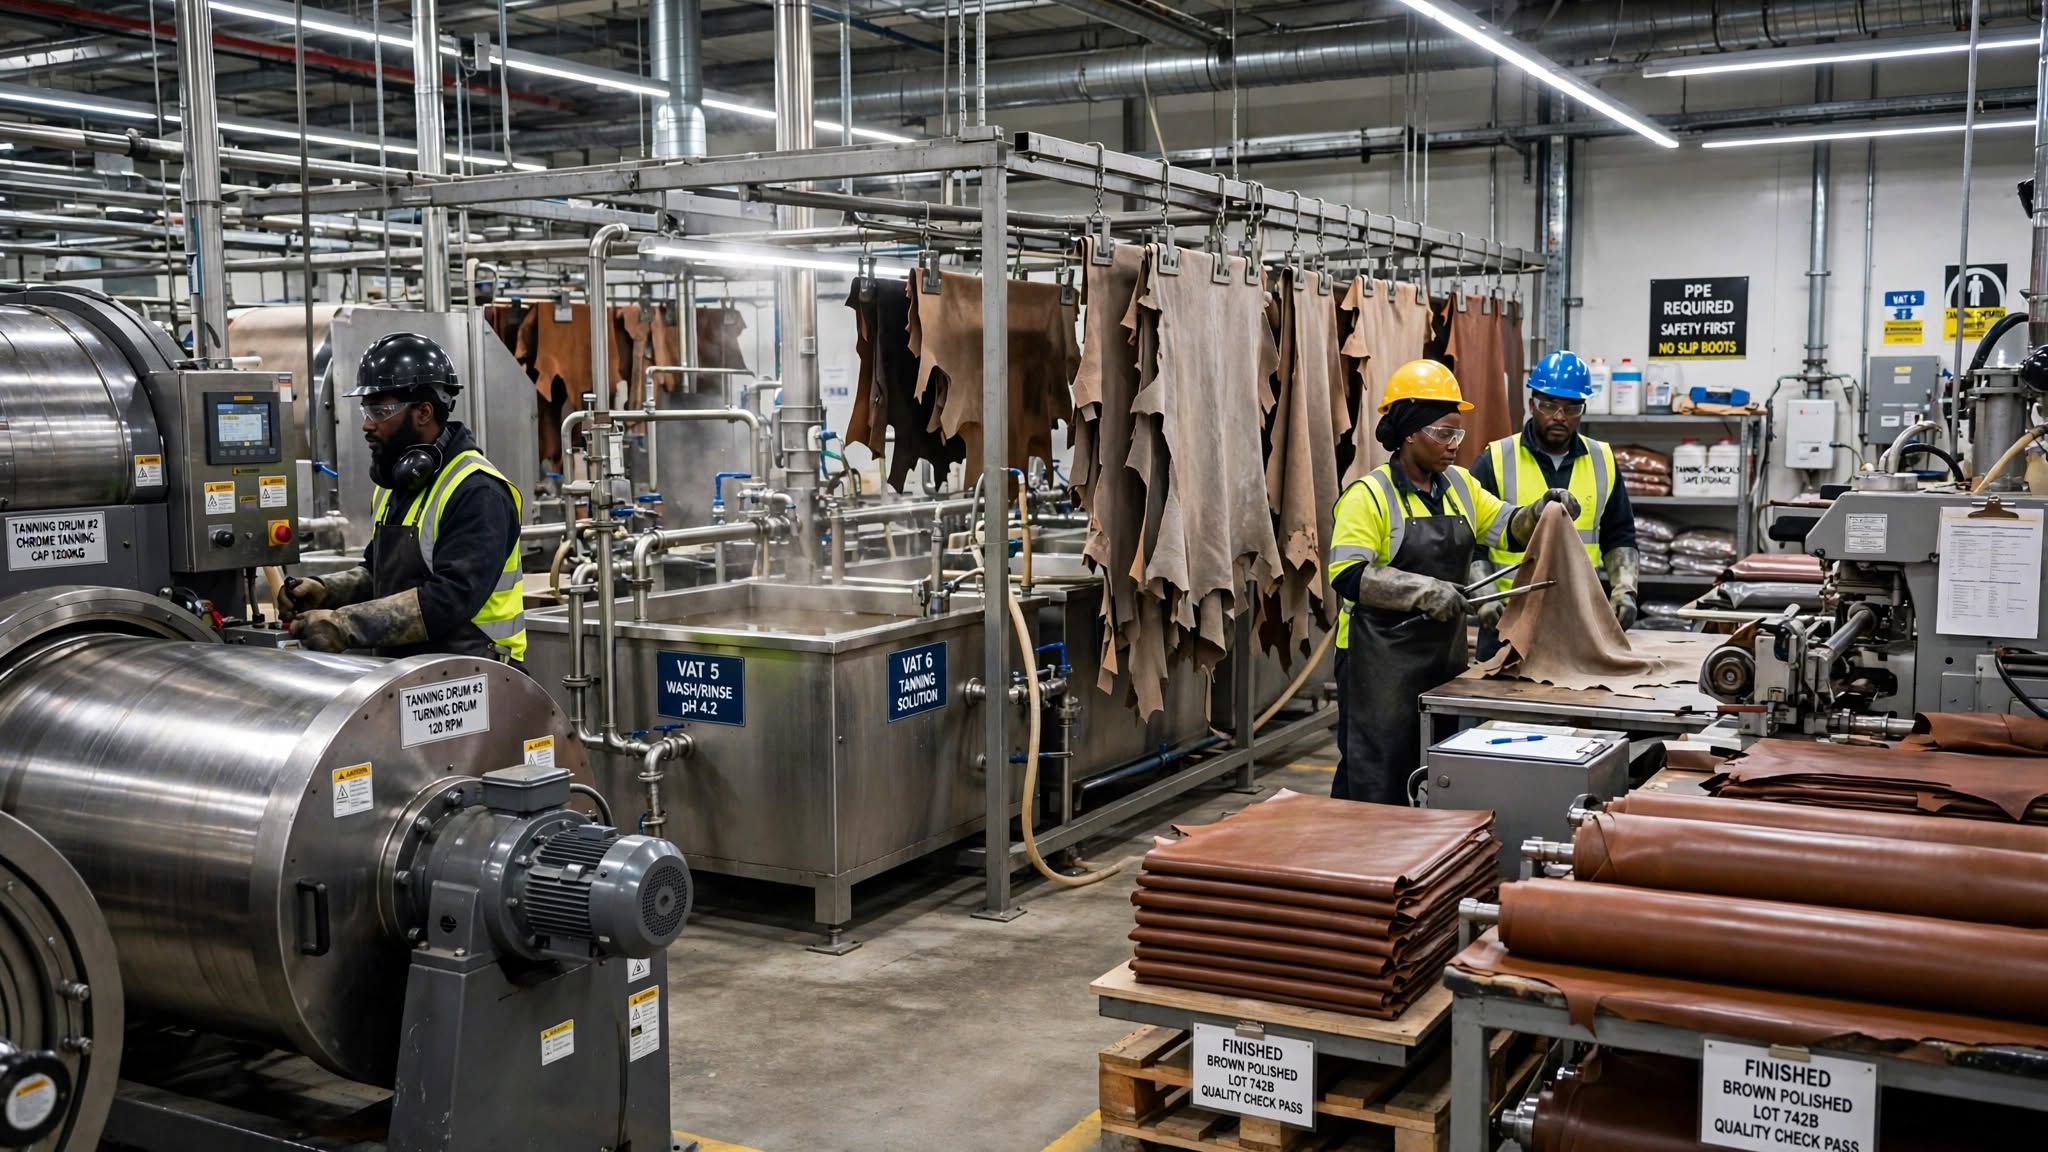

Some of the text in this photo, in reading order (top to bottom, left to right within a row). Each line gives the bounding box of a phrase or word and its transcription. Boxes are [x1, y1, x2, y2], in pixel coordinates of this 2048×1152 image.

[1685, 284, 1712, 298] PPE
[1664, 300, 1734, 316] REQUIRED
[1661, 321, 1735, 336] SAFETY FIRST
[1659, 341, 1736, 354] NO SLIP BOOTS
[12, 519, 98, 534] TANNING DRUM #2
[16, 533, 95, 548] CHROME TANNING
[31, 550, 49, 561] CAP
[677, 660, 719, 680] VAT 5
[902, 652, 933, 674] VAT 6
[666, 680, 733, 699] WASH/RINSE
[899, 672, 935, 693] TANNING
[406, 682, 482, 707] TANNING DRUM #3
[897, 689, 938, 711] SOLUTION
[412, 699, 476, 721] TURNING DRUM
[682, 700, 717, 715] pH 4.2
[428, 718, 463, 734] 120 RPM
[1222, 1039, 1283, 1061] FINISHED
[1207, 1055, 1298, 1081] BROWN POLISHED
[1745, 1059, 1831, 1088] FINISHED
[1228, 1074, 1275, 1092] LOT 742B
[1201, 1085, 1303, 1114] QUALITY CHECK PASS
[1723, 1080, 1852, 1113] BROWN POLISHED
[1753, 1105, 1819, 1128] LOT 742B
[1714, 1118, 1859, 1152] QUALITY CHECK PASS
